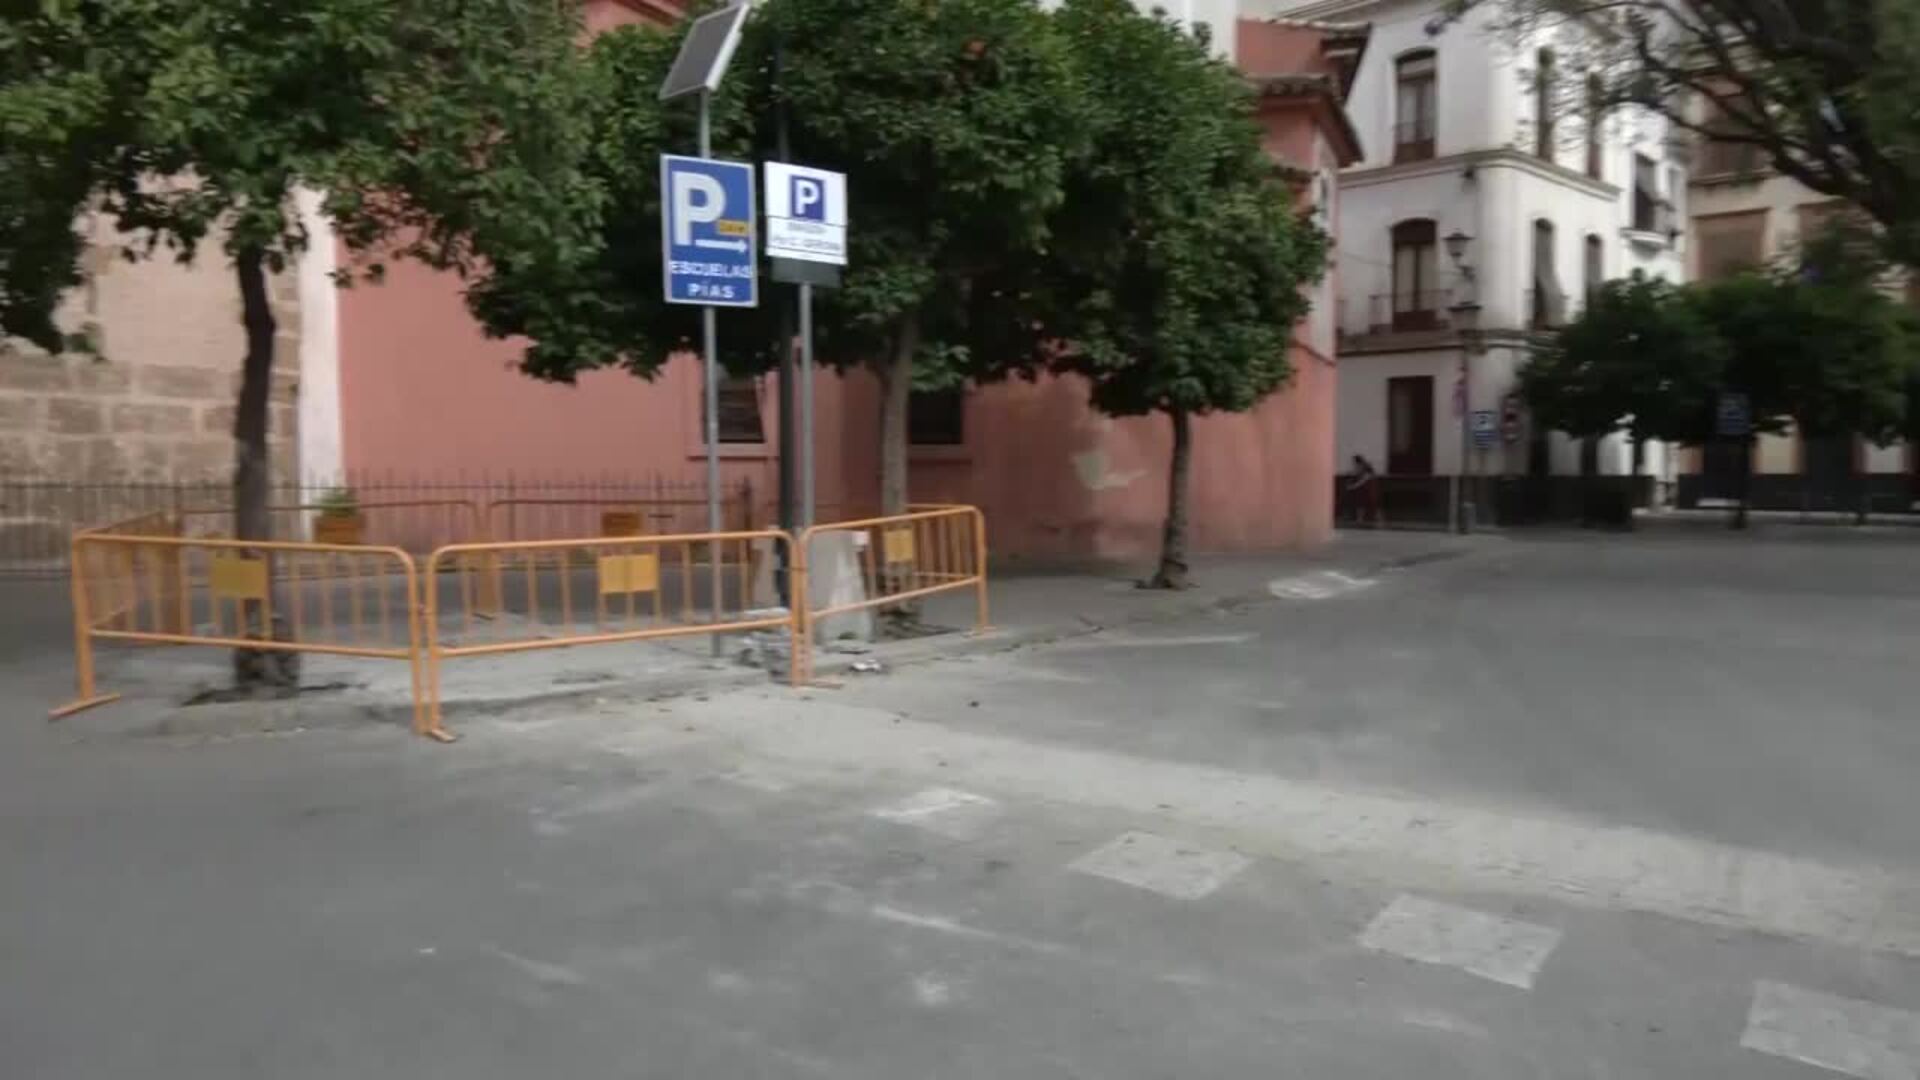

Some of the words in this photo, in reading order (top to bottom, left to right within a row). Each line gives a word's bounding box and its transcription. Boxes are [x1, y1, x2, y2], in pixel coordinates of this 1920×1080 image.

[672, 171, 726, 246] P
[795, 180, 819, 215] P
[670, 261, 753, 279] ESCUELAS
